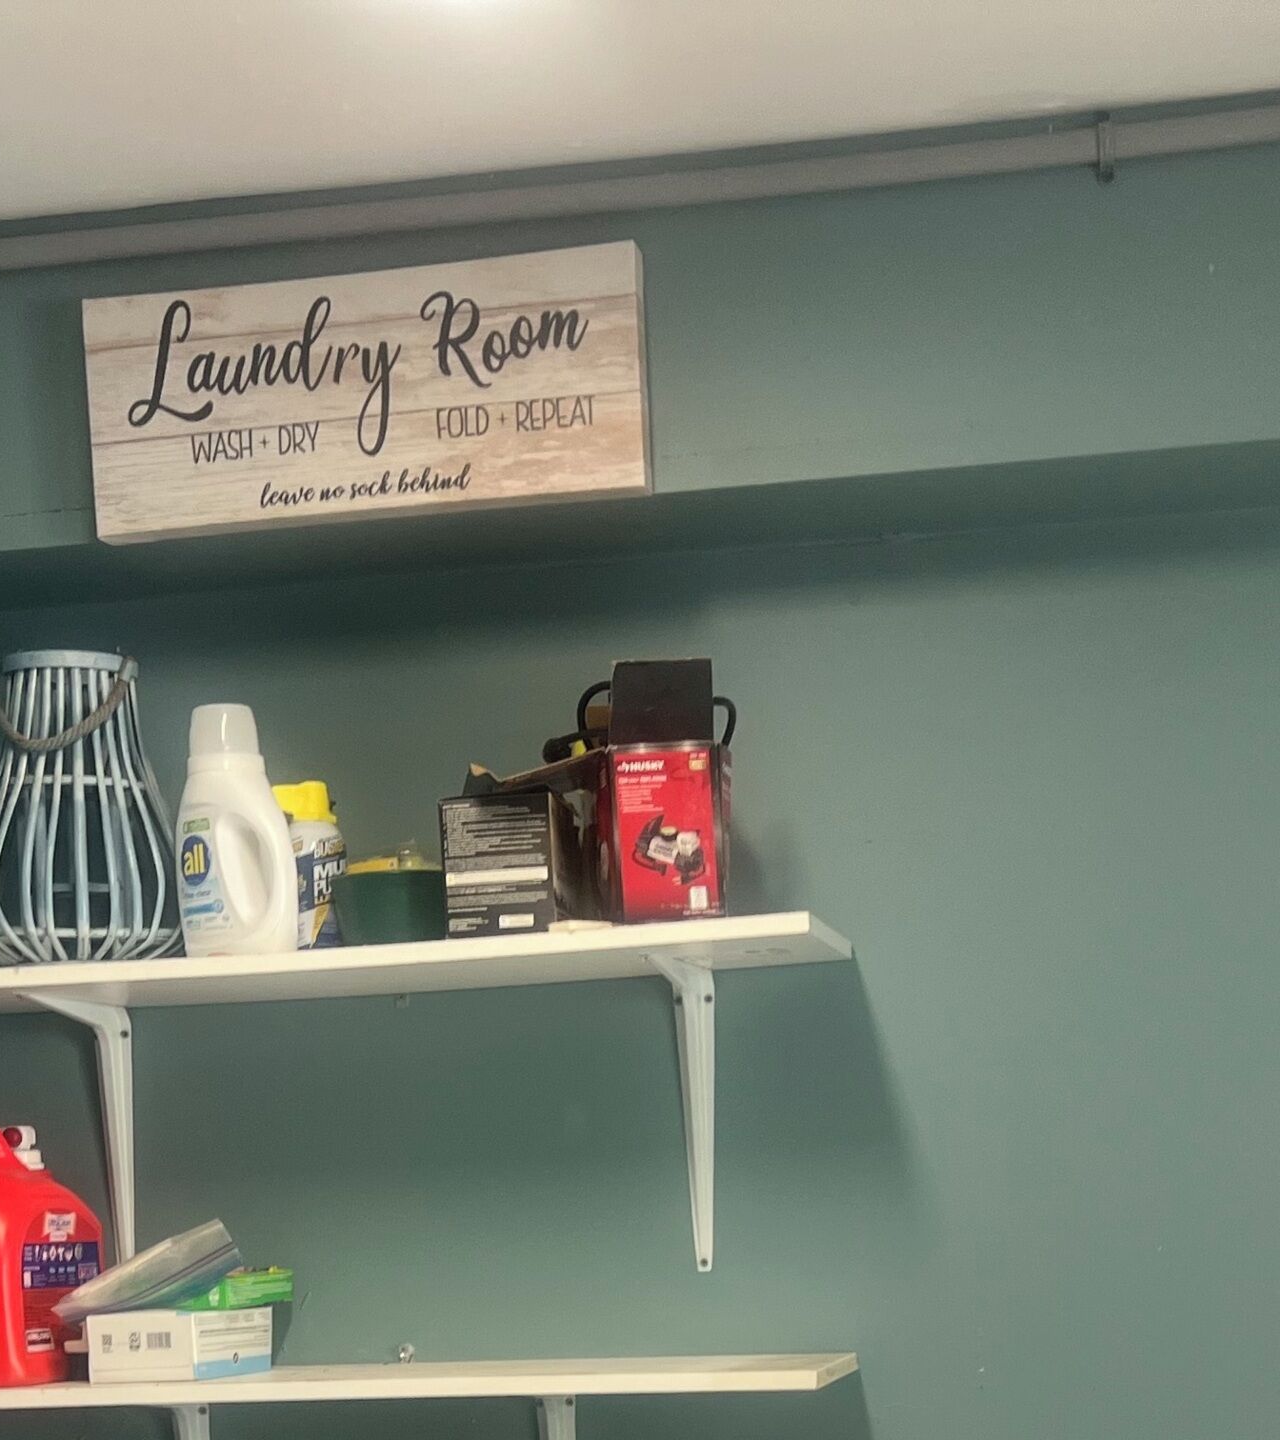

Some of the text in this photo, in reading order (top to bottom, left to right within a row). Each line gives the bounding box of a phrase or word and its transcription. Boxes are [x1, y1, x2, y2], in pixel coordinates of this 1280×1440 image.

[128, 290, 589, 456] Laundry Room
[436, 405, 490, 439] FOLD
[515, 394, 595, 433] REPEAT
[191, 429, 253, 464] WASH
[278, 421, 320, 456] DRY
[260, 463, 472, 508] leave no sock behind
[183, 842, 206, 876] all
